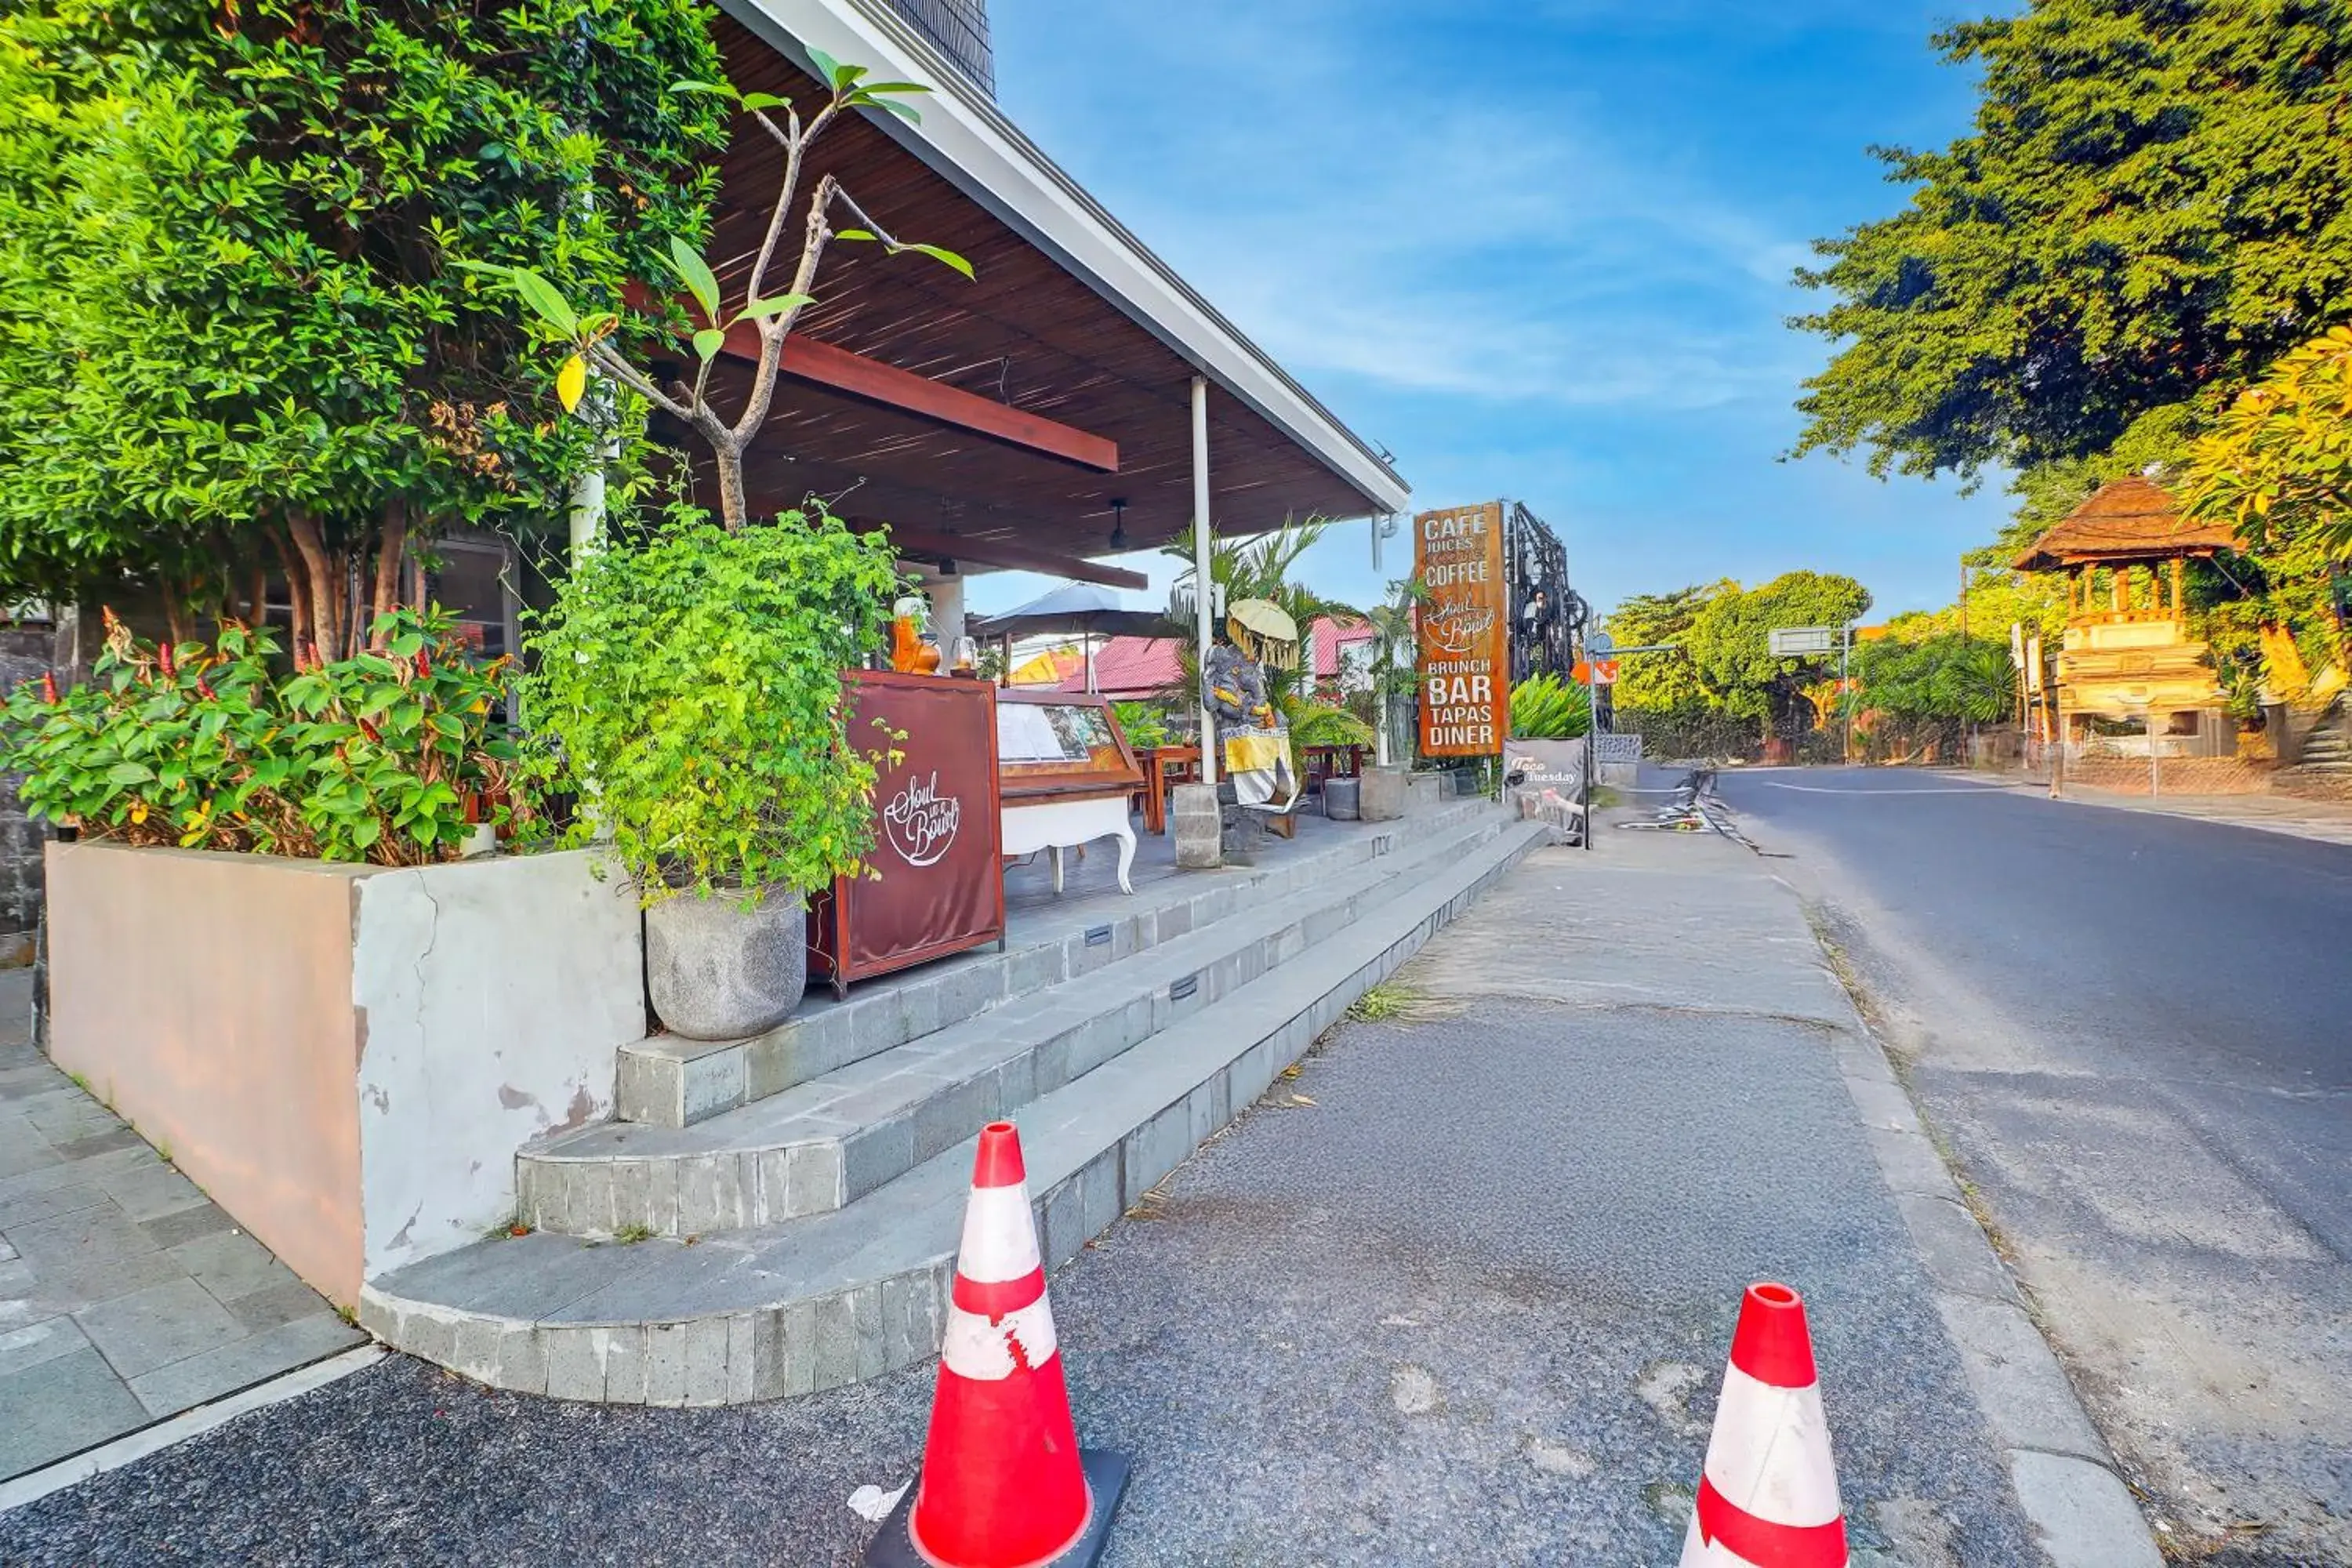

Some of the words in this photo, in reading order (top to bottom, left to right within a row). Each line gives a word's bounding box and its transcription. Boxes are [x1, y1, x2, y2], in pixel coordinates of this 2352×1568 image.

[1425, 513, 1486, 539] CAFE
[1426, 561, 1489, 586] COFFEE
[1428, 660, 1490, 674] BRUNCH
[1428, 676, 1492, 706] BAR
[1430, 706, 1492, 724] TAPAS
[1430, 726, 1493, 745] DINER
[1526, 771, 1576, 784] Tuesday
[892, 771, 938, 823] Soul
